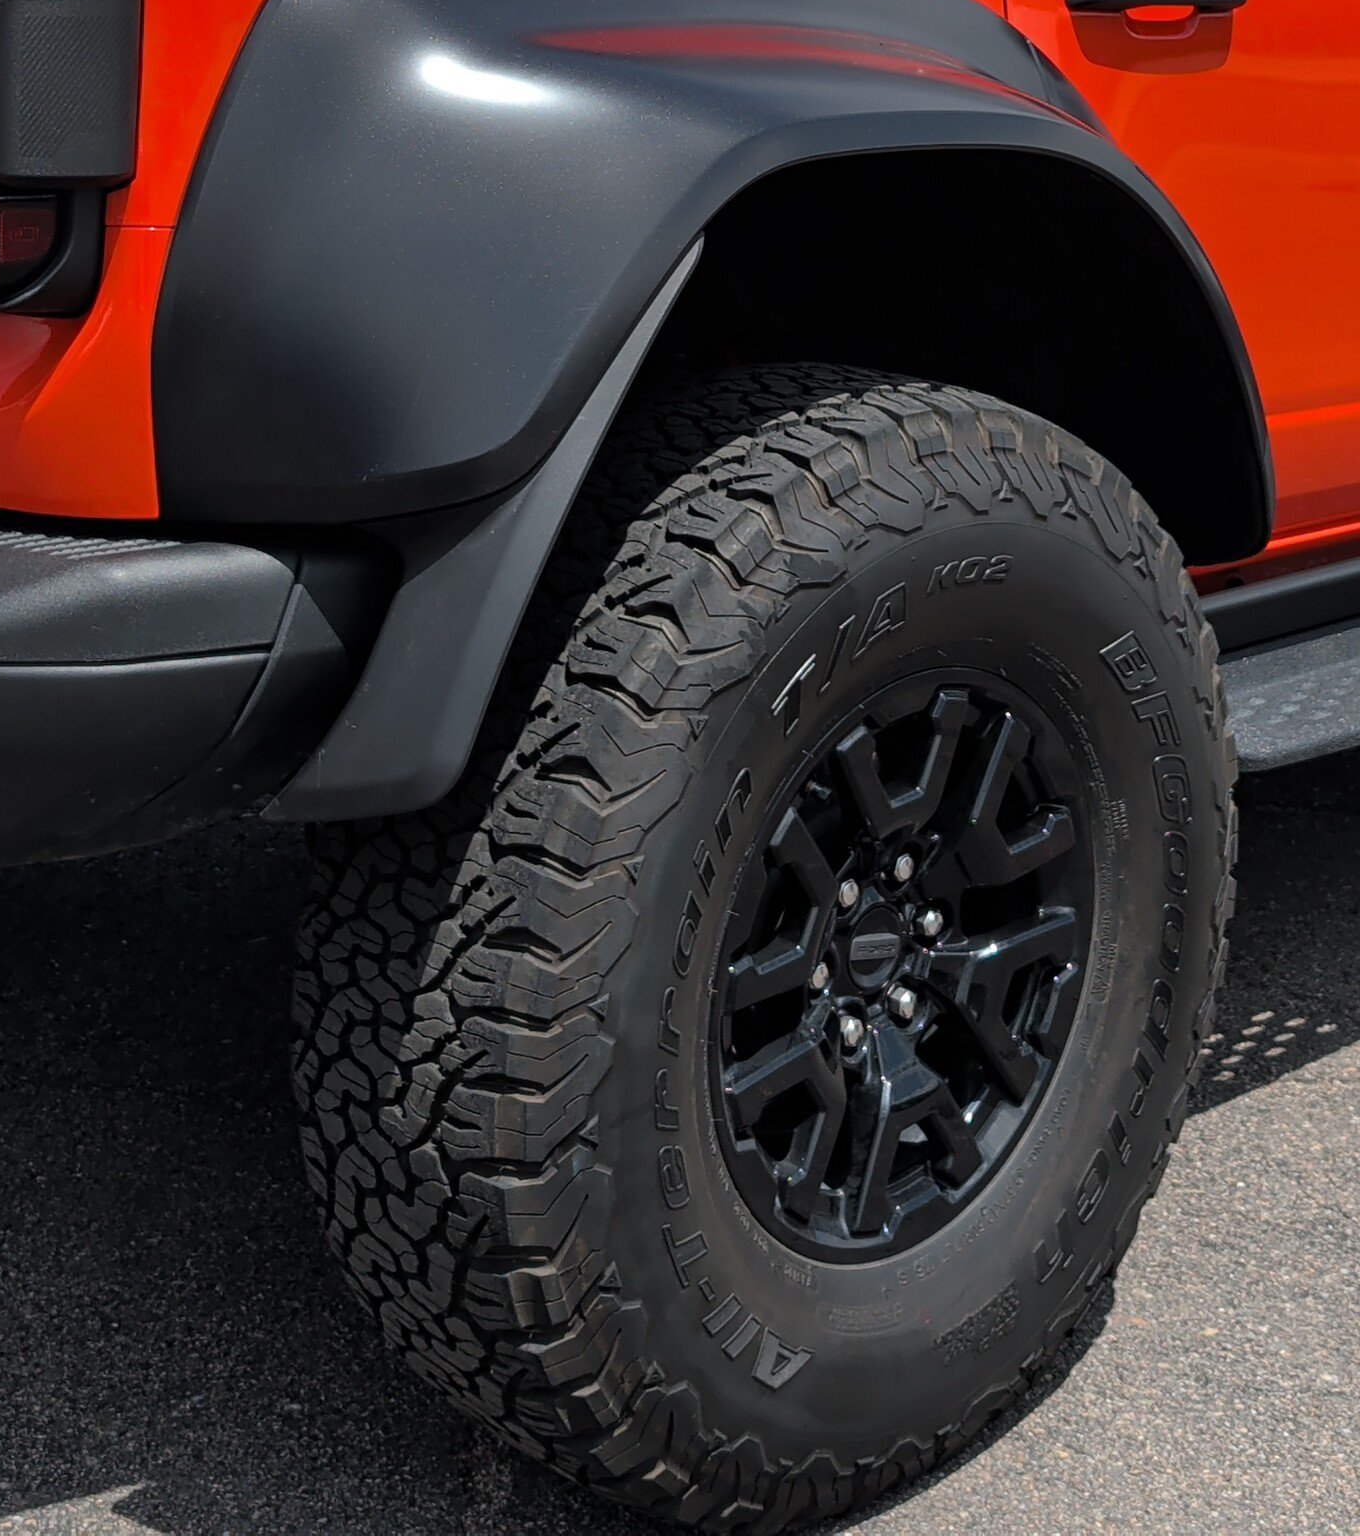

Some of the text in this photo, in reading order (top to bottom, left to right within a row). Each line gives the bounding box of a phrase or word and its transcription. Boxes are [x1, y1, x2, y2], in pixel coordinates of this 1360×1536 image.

[654, 553, 1013, 1391] All-Terrain T/A KO2
[1030, 629, 1192, 1286] BFGoodrich
